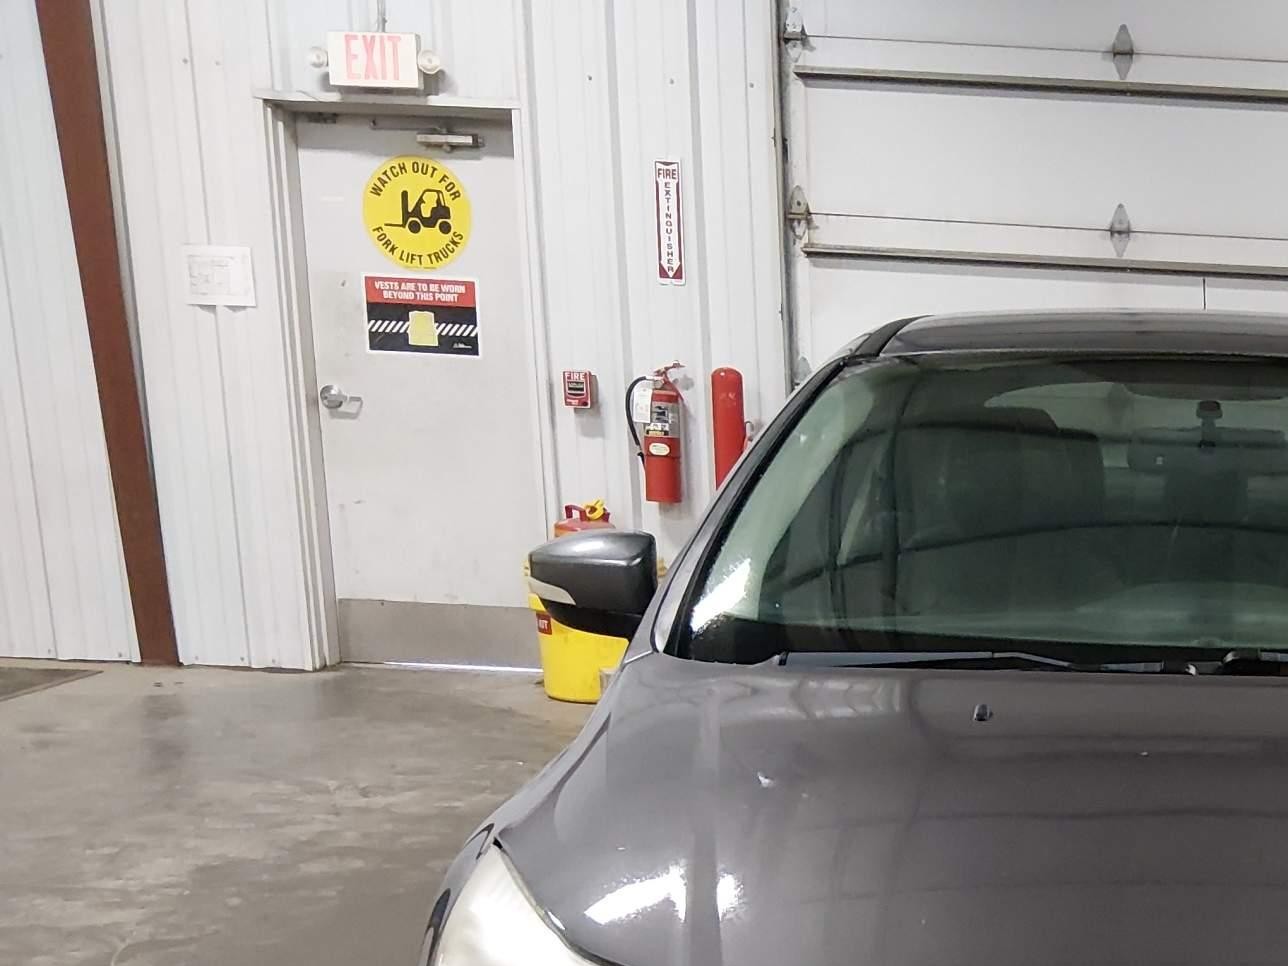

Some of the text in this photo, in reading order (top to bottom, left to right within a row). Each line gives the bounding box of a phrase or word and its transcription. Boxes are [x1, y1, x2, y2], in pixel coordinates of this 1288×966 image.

[344, 34, 401, 80] EXIT
[370, 161, 461, 200] WATCH OUT FOR
[657, 168, 677, 179] FIRE
[664, 182, 674, 272] EXTINGUISHER
[372, 226, 464, 265] FORK LIFT TRUCKS
[374, 281, 466, 293] VESTS ARE TO BE WORN
[383, 290, 459, 302] BEYOND THIS POINT
[565, 372, 585, 380] FIRE
